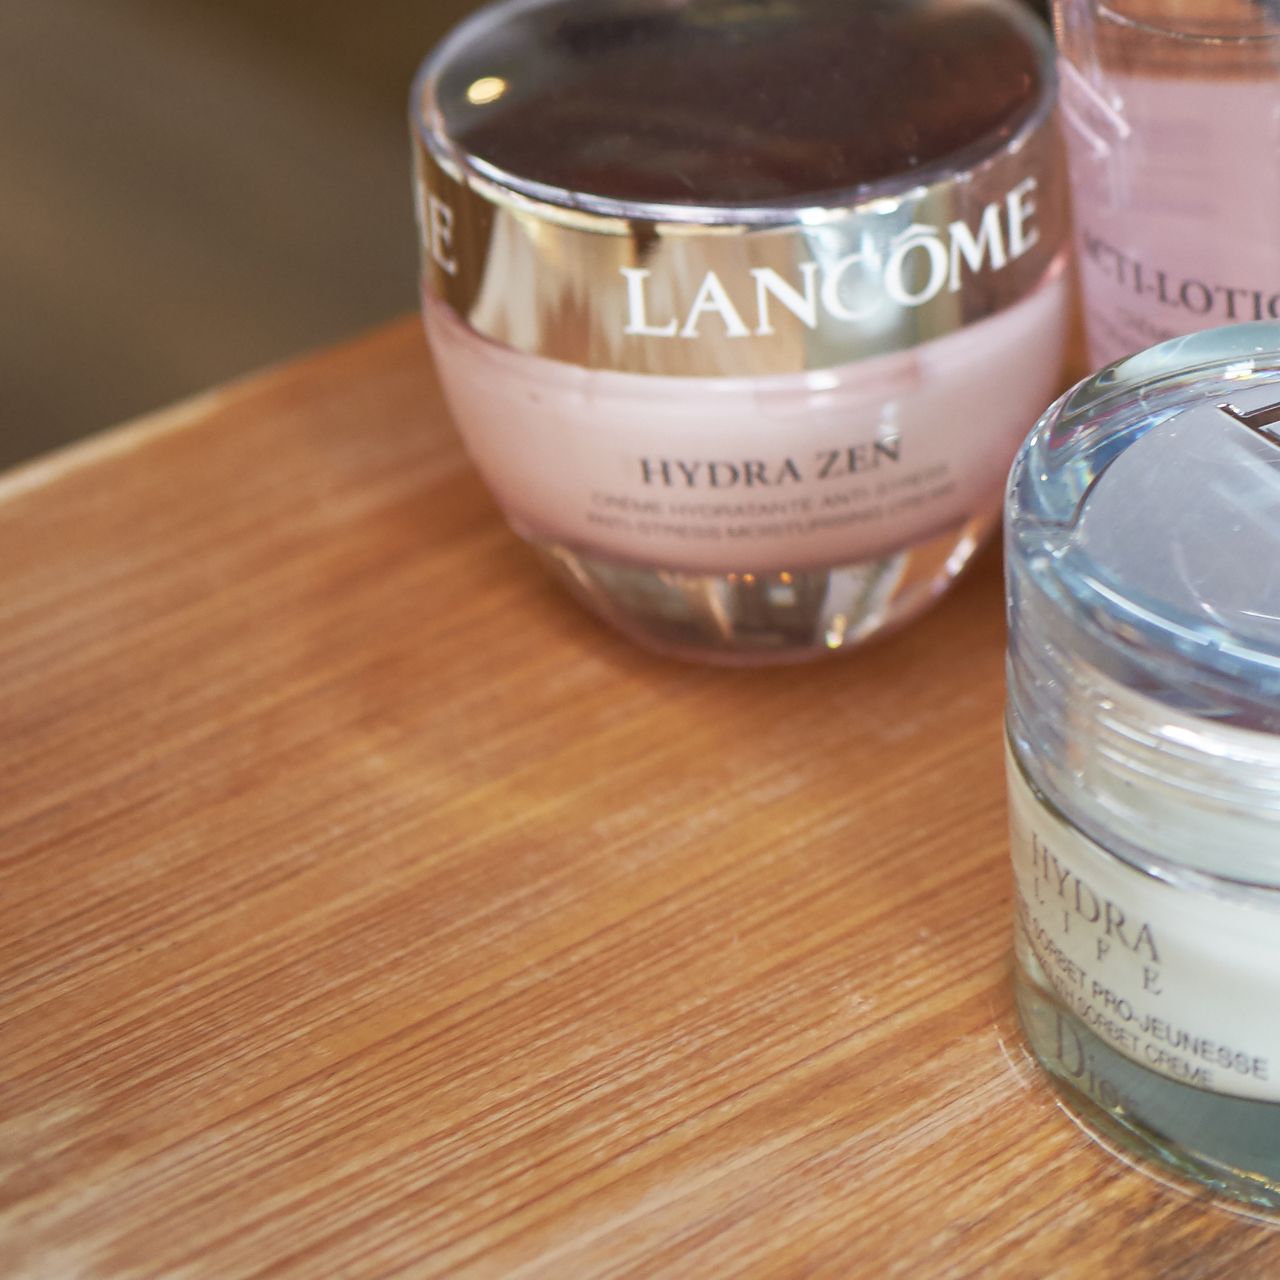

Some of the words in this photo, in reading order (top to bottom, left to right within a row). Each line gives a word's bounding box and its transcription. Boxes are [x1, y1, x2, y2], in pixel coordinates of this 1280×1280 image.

[619, 177, 1041, 338] LANCÔME
[639, 455, 804, 489] HYDRA
[815, 436, 902, 480] ZEN
[1031, 831, 1161, 963] HYDRA
[1091, 978, 1270, 1082] PRO-JEUNESSE
